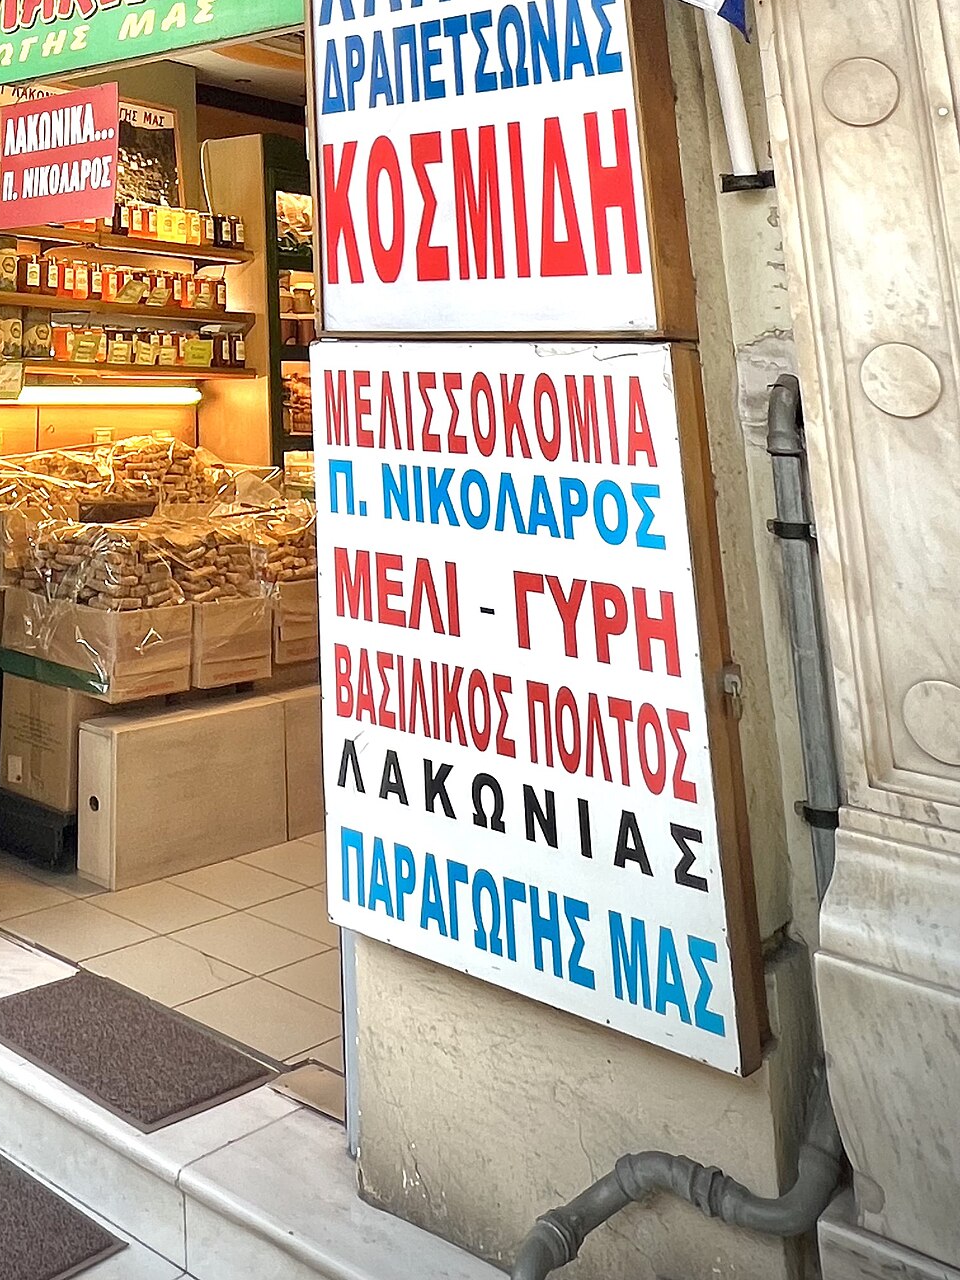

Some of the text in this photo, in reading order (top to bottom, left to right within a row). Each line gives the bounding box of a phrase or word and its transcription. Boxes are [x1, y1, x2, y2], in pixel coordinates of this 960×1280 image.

[2, 155, 113, 202] Π. ΝΙΚΟΛΑΡΟΣ
[119, 108, 138, 122] ΓΗΣ
[143, 111, 165, 127] ΜΑΣ
[323, 108, 642, 284] ΚΟΣΜΙΔΗ
[324, 369, 658, 468] ΜΕΛΙΣΣΟΚΟΜΙΑ
[328, 459, 667, 550] Π. ΝΙΚΟΛΑΡΟΣ
[334, 547, 461, 638] ΜΕΛΙ
[512, 570, 682, 678] ΓΥΡΗ
[334, 643, 698, 804] ΒΑΣΙΛΙΚΟΣ ΠΟΛΤΟΣ
[337, 738, 709, 893] ΛΑΚΩΝΙΑΣ
[340, 826, 727, 1037] ΠΑΡΑΓΩΓΗΣ ΜΑΣ
